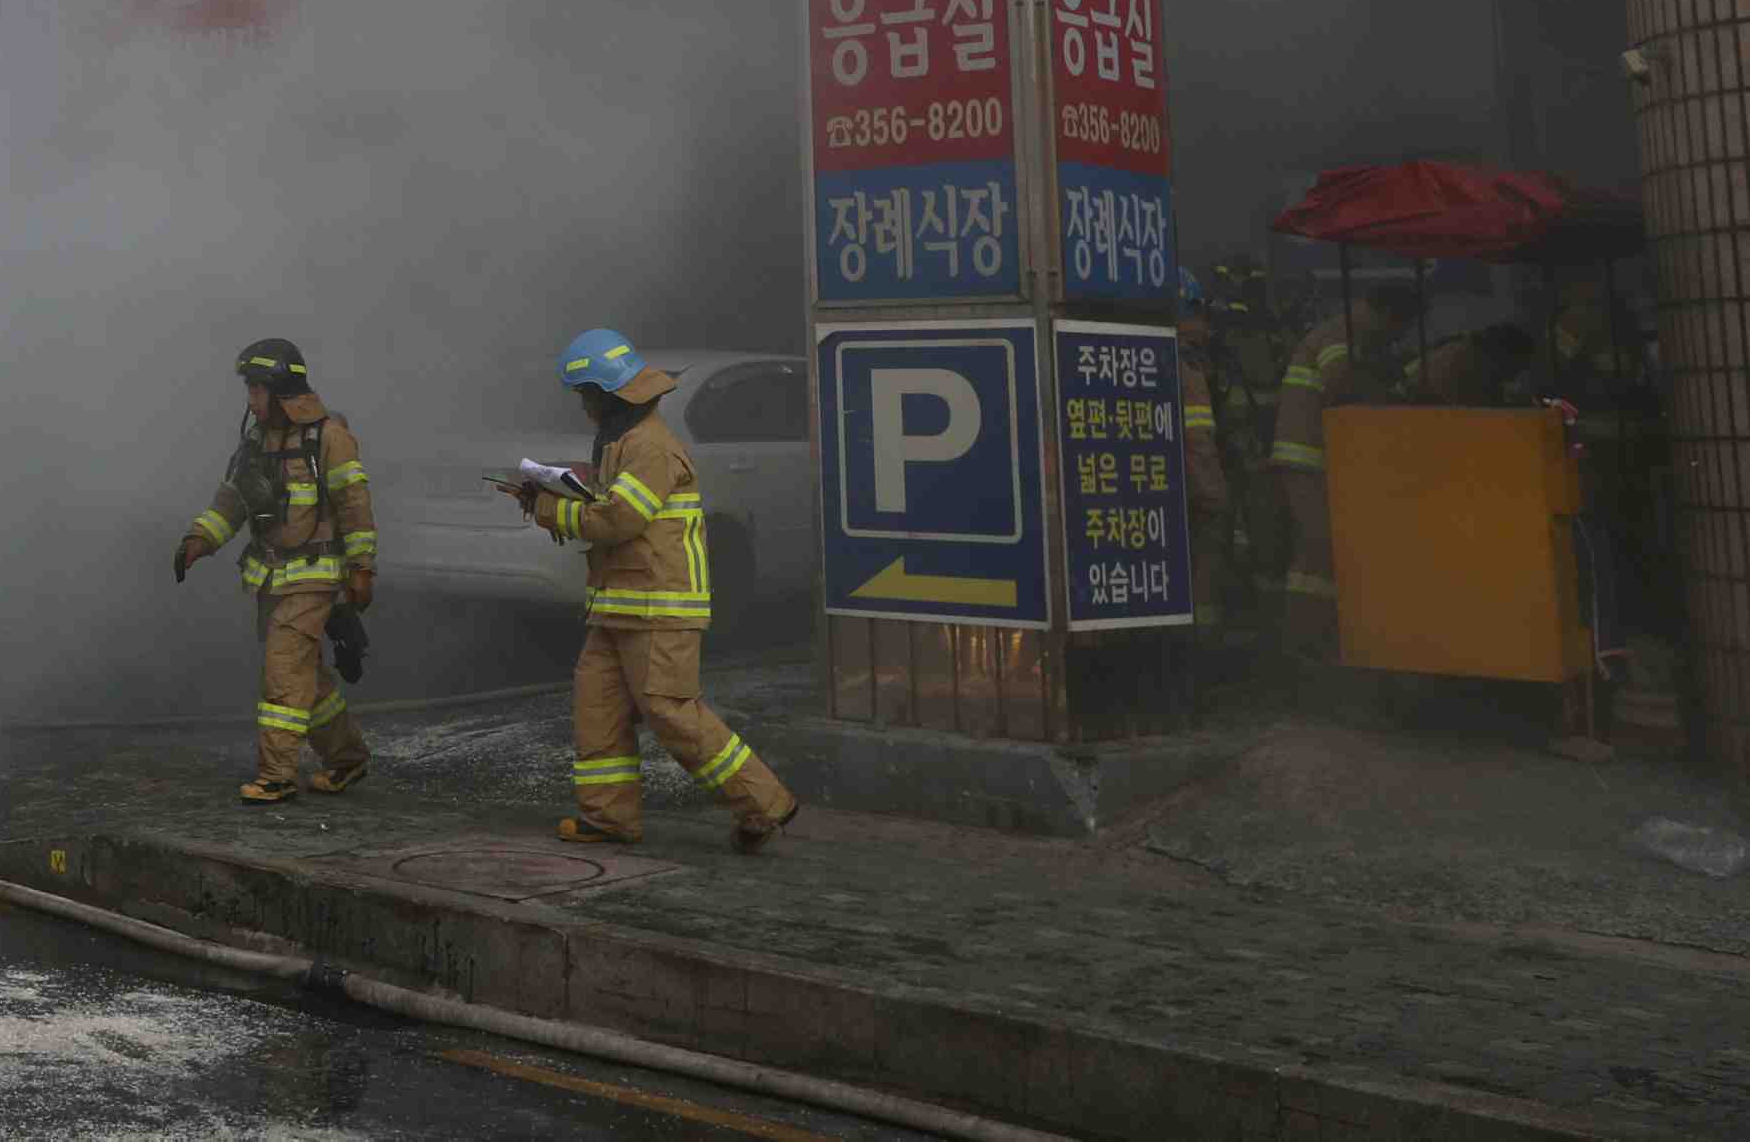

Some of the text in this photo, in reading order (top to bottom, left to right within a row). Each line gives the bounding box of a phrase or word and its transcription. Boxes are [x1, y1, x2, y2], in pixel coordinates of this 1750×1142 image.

[856, 97, 1003, 147] 356-8200
[1078, 103, 1161, 154] 356-8200
[827, 181, 1009, 283] 장례식장
[1065, 185, 1167, 288] 장례식장
[1077, 345, 1158, 388] 주차장은
[869, 367, 982, 514] P
[1077, 452, 1169, 494] 넓은 무료
[1085, 506, 1166, 550] 주차장이
[1089, 560, 1169, 604] 있습니다
